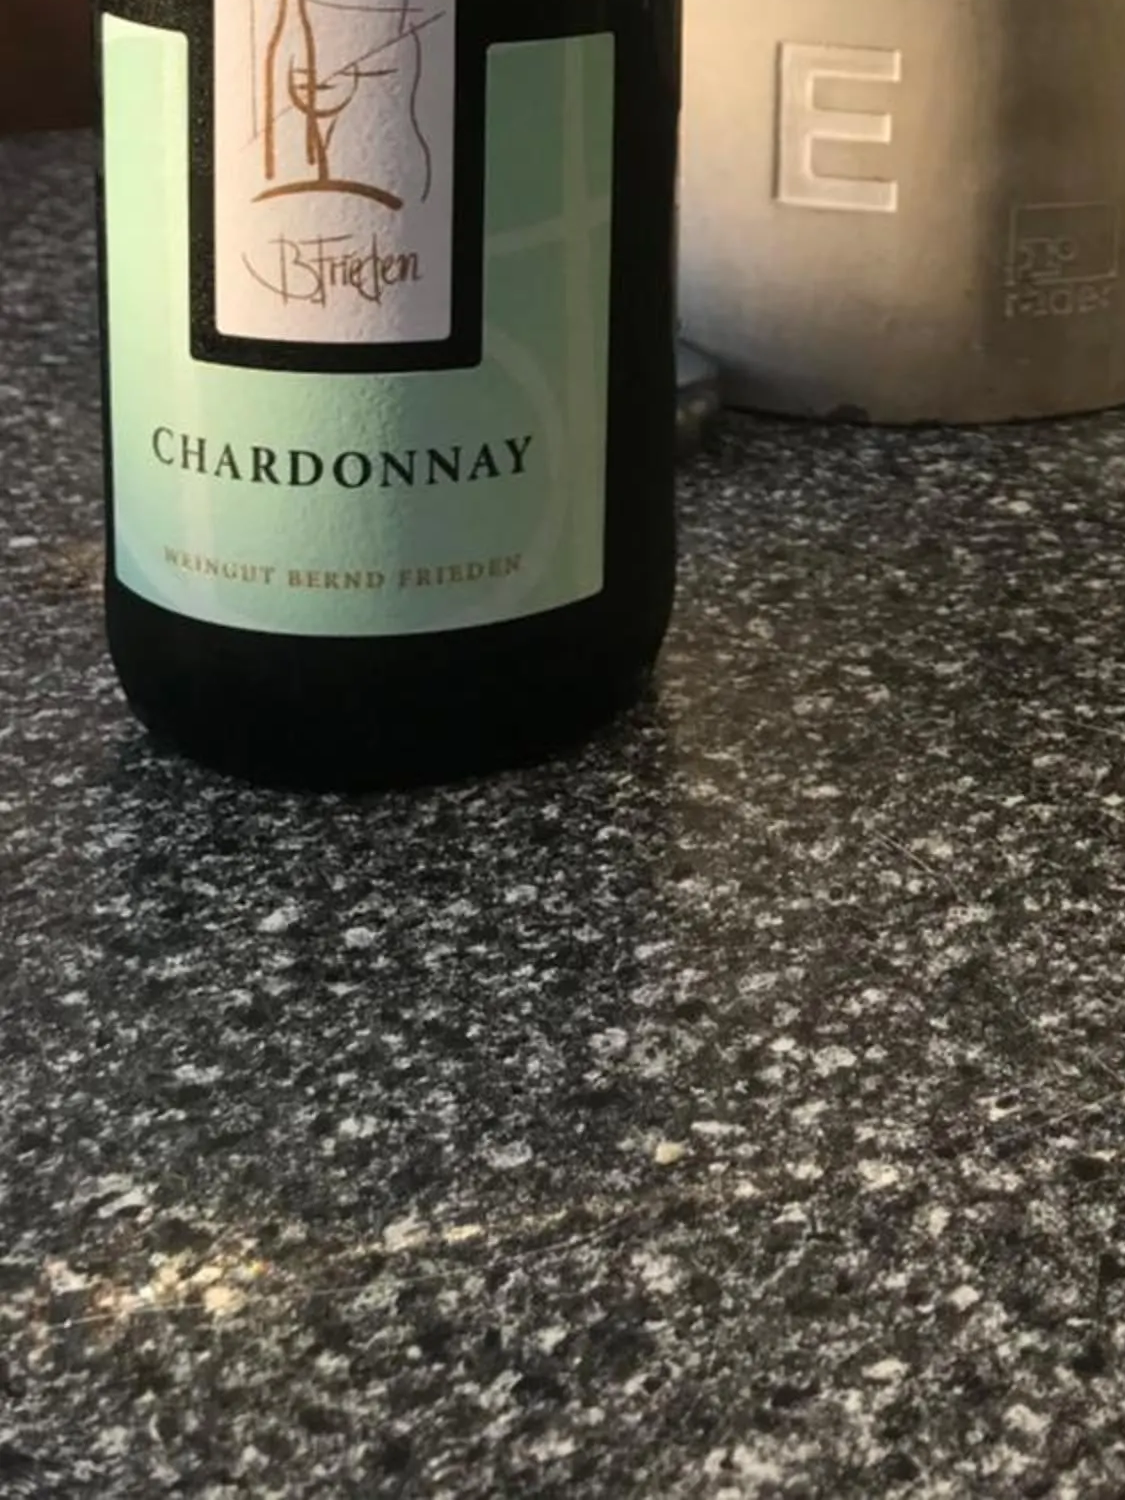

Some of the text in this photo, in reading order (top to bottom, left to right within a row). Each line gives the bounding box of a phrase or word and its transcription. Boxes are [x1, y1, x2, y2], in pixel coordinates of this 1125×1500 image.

[152, 425, 533, 489] CHARDONNAY
[164, 545, 523, 591] WEINGUT BERND FRIEDEN
